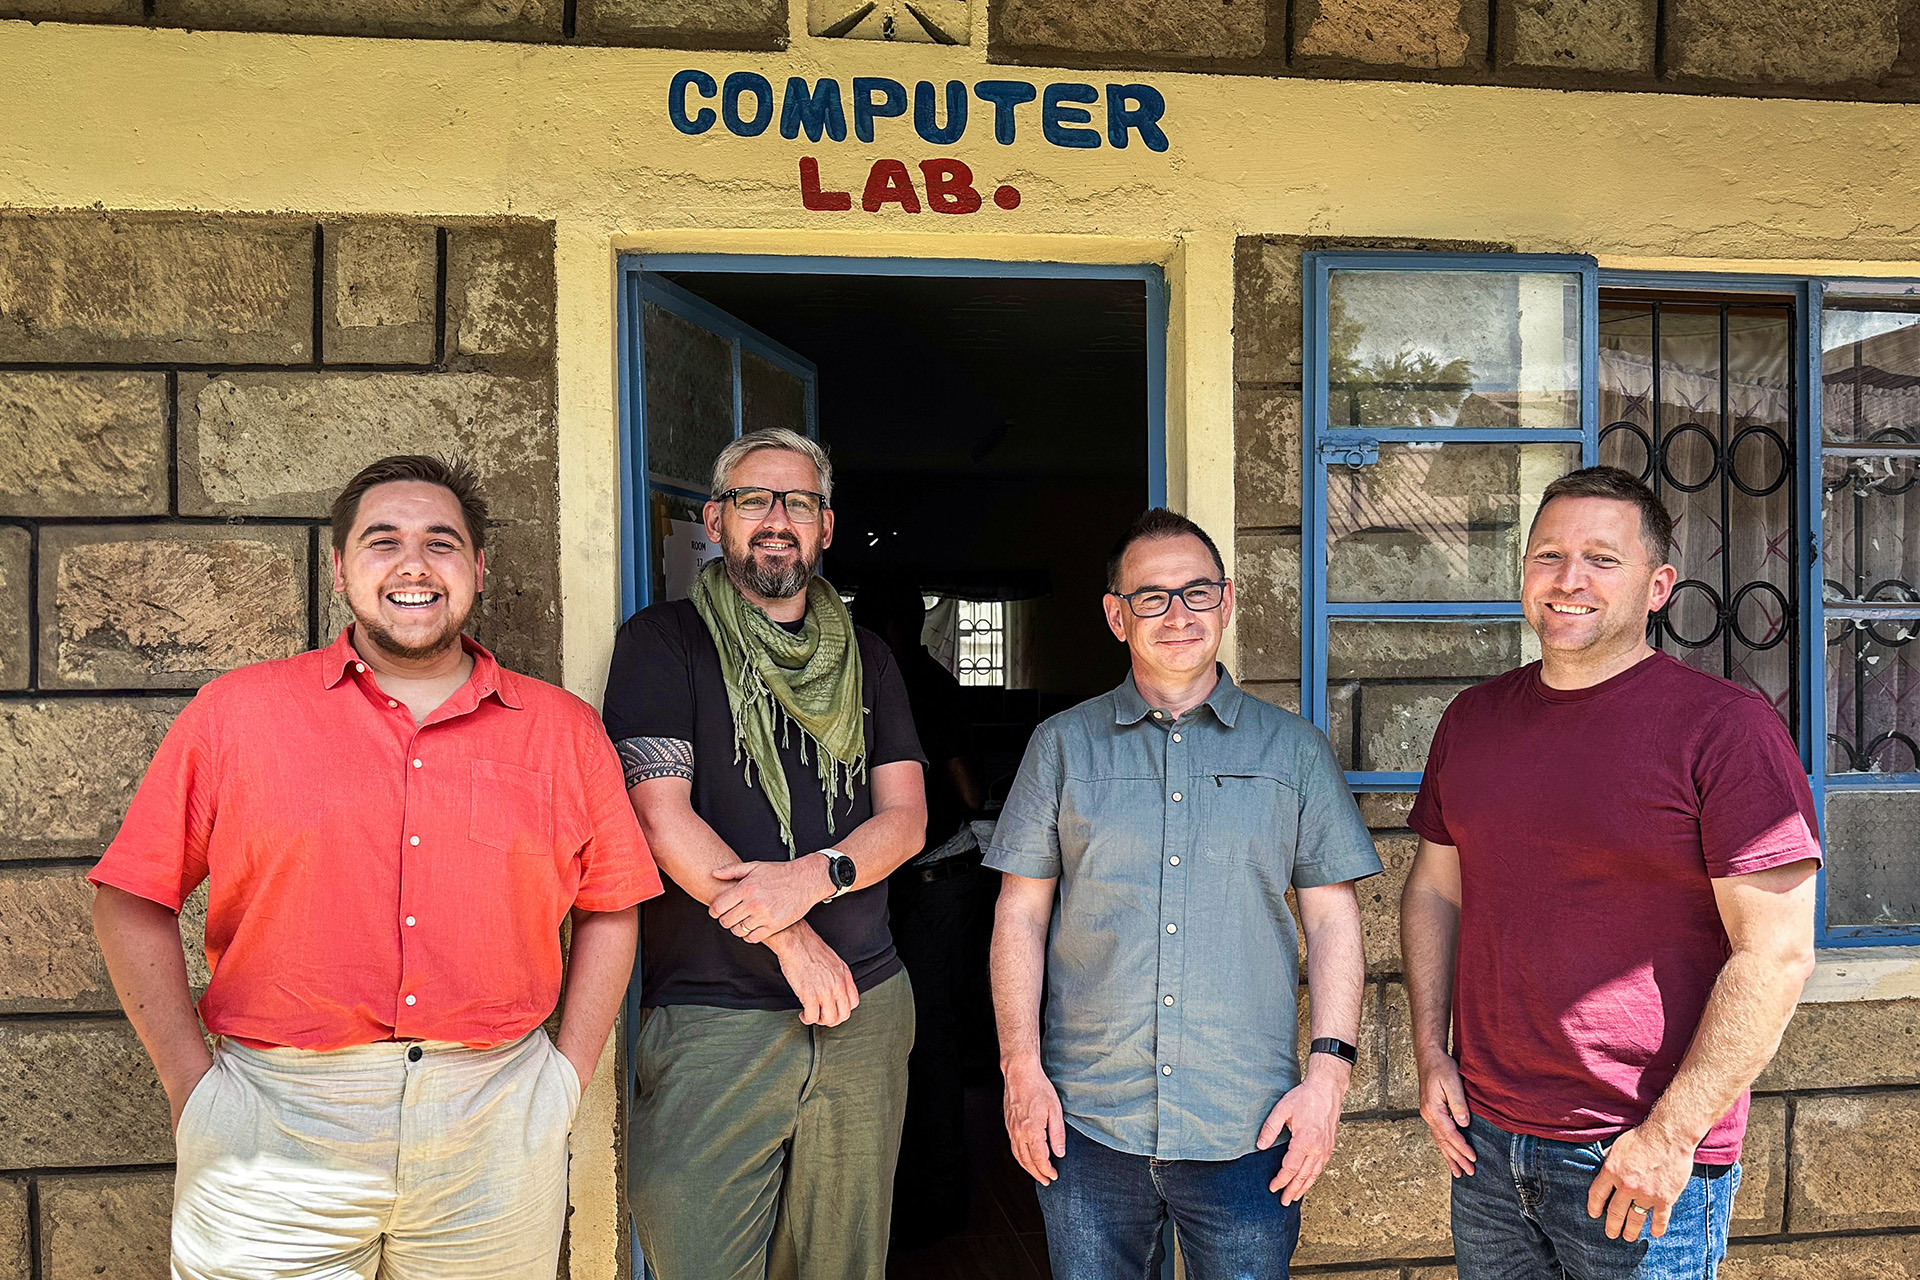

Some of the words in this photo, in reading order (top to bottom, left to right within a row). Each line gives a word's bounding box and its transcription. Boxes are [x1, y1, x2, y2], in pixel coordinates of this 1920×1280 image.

[668, 70, 1169, 152] COMPUTER
[800, 157, 1021, 214] LAB.
[691, 540, 707, 551] ROOM
